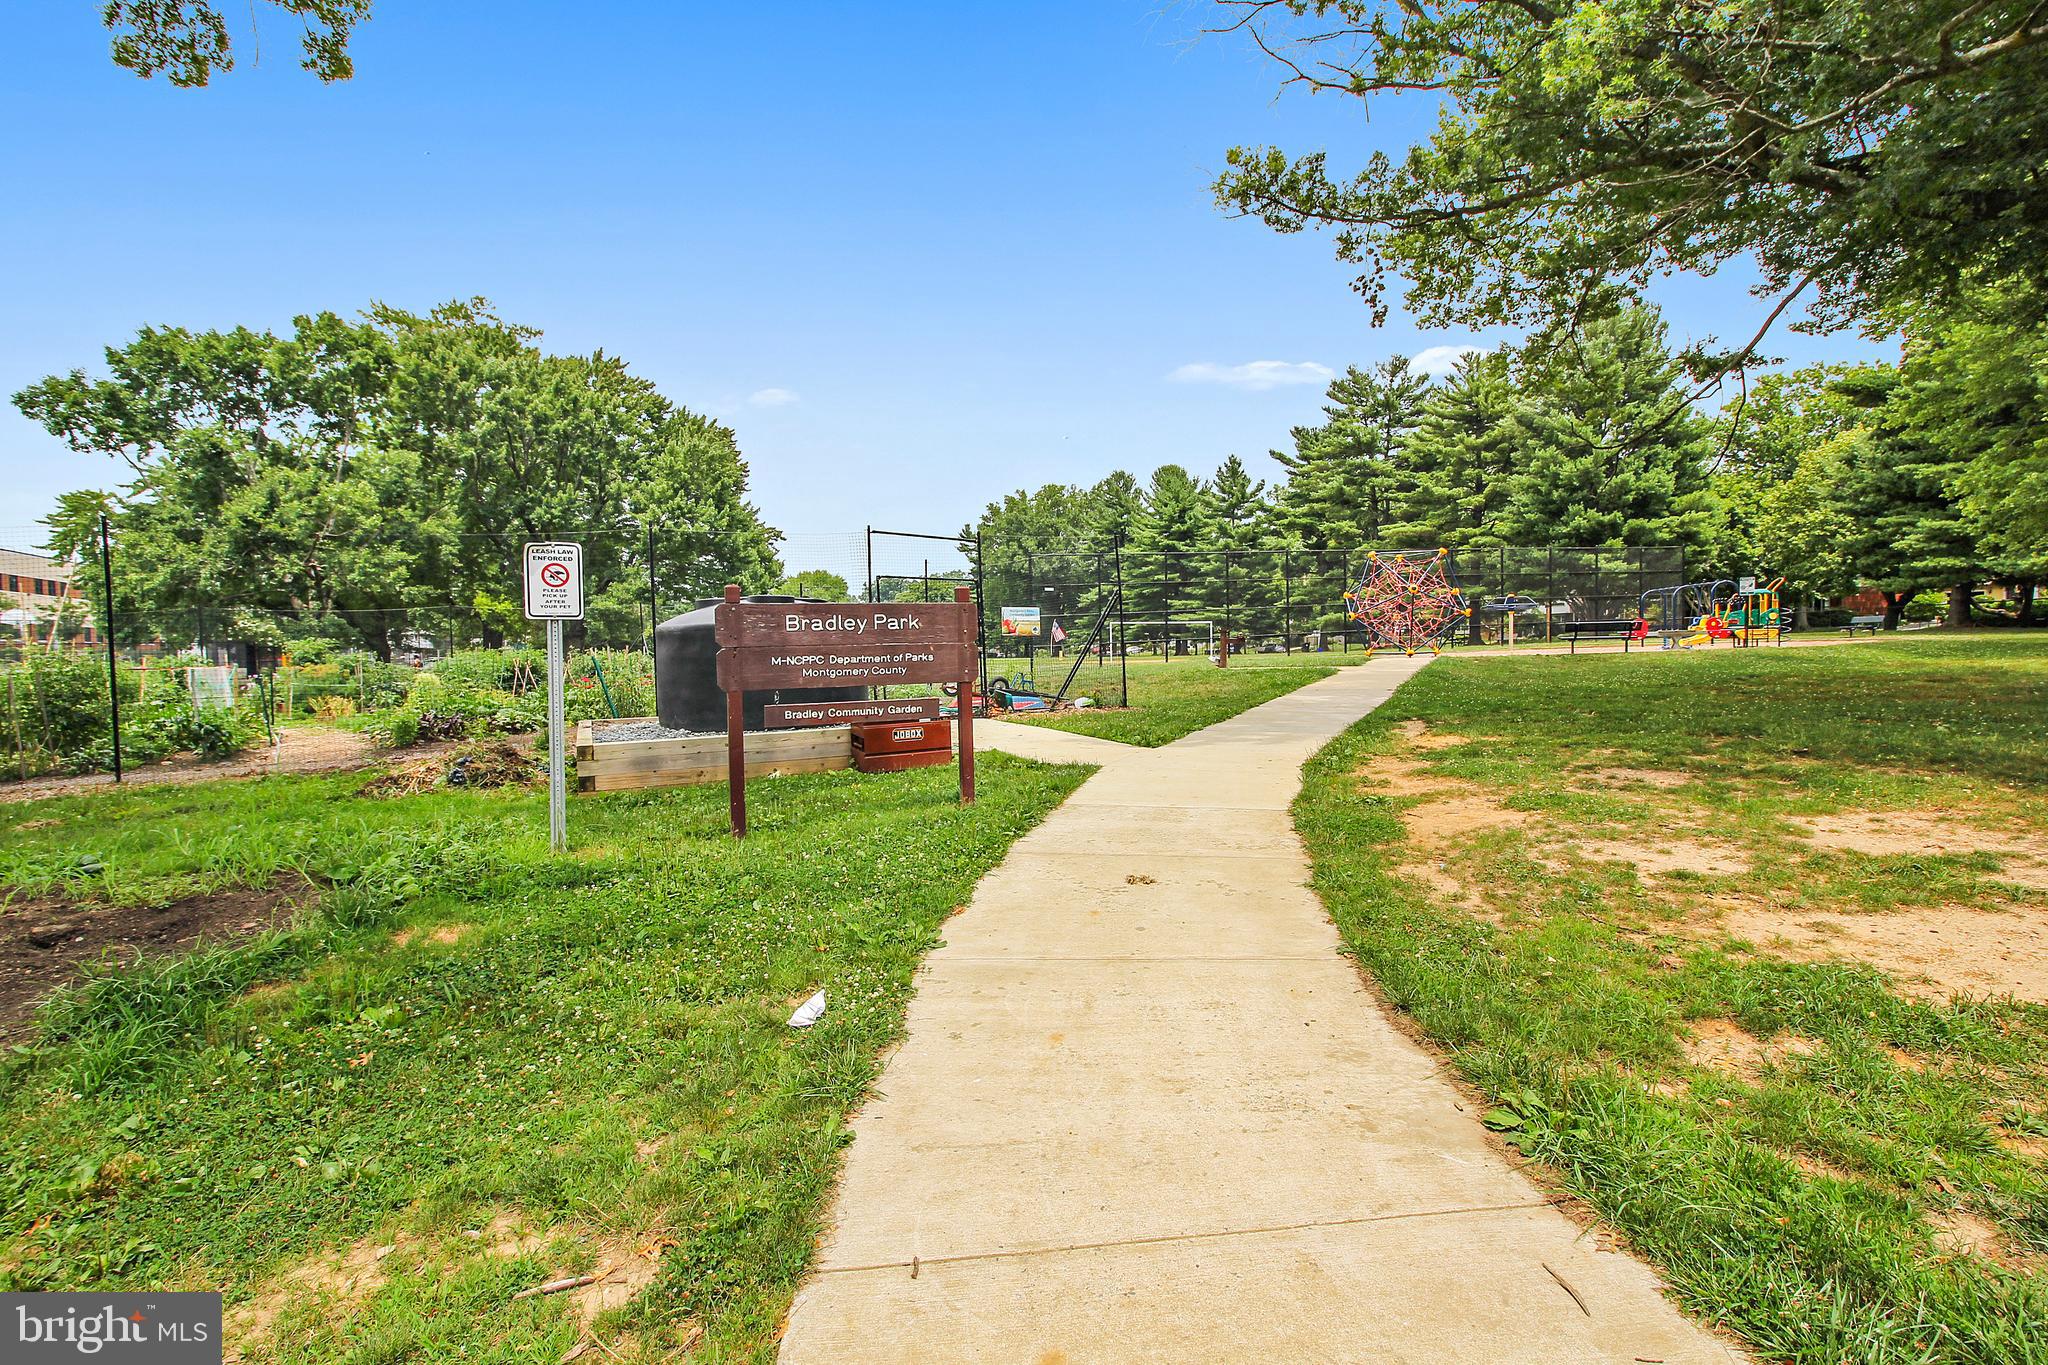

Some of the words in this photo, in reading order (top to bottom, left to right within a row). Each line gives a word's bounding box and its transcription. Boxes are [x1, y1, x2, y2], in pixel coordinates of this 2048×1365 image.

[785, 613, 868, 635] Bradley
[873, 613, 921, 630] Park
[771, 654, 825, 666] M-NCPPC
[829, 654, 892, 666] Department
[893, 653, 904, 663] of
[905, 652, 934, 662] Parks
[802, 666, 870, 678] Montgomery
[871, 666, 908, 677] County
[784, 708, 824, 721] Bradley
[828, 706, 884, 718] Community
[888, 704, 923, 714] Garden
[894, 730, 922, 740] JOBOX
